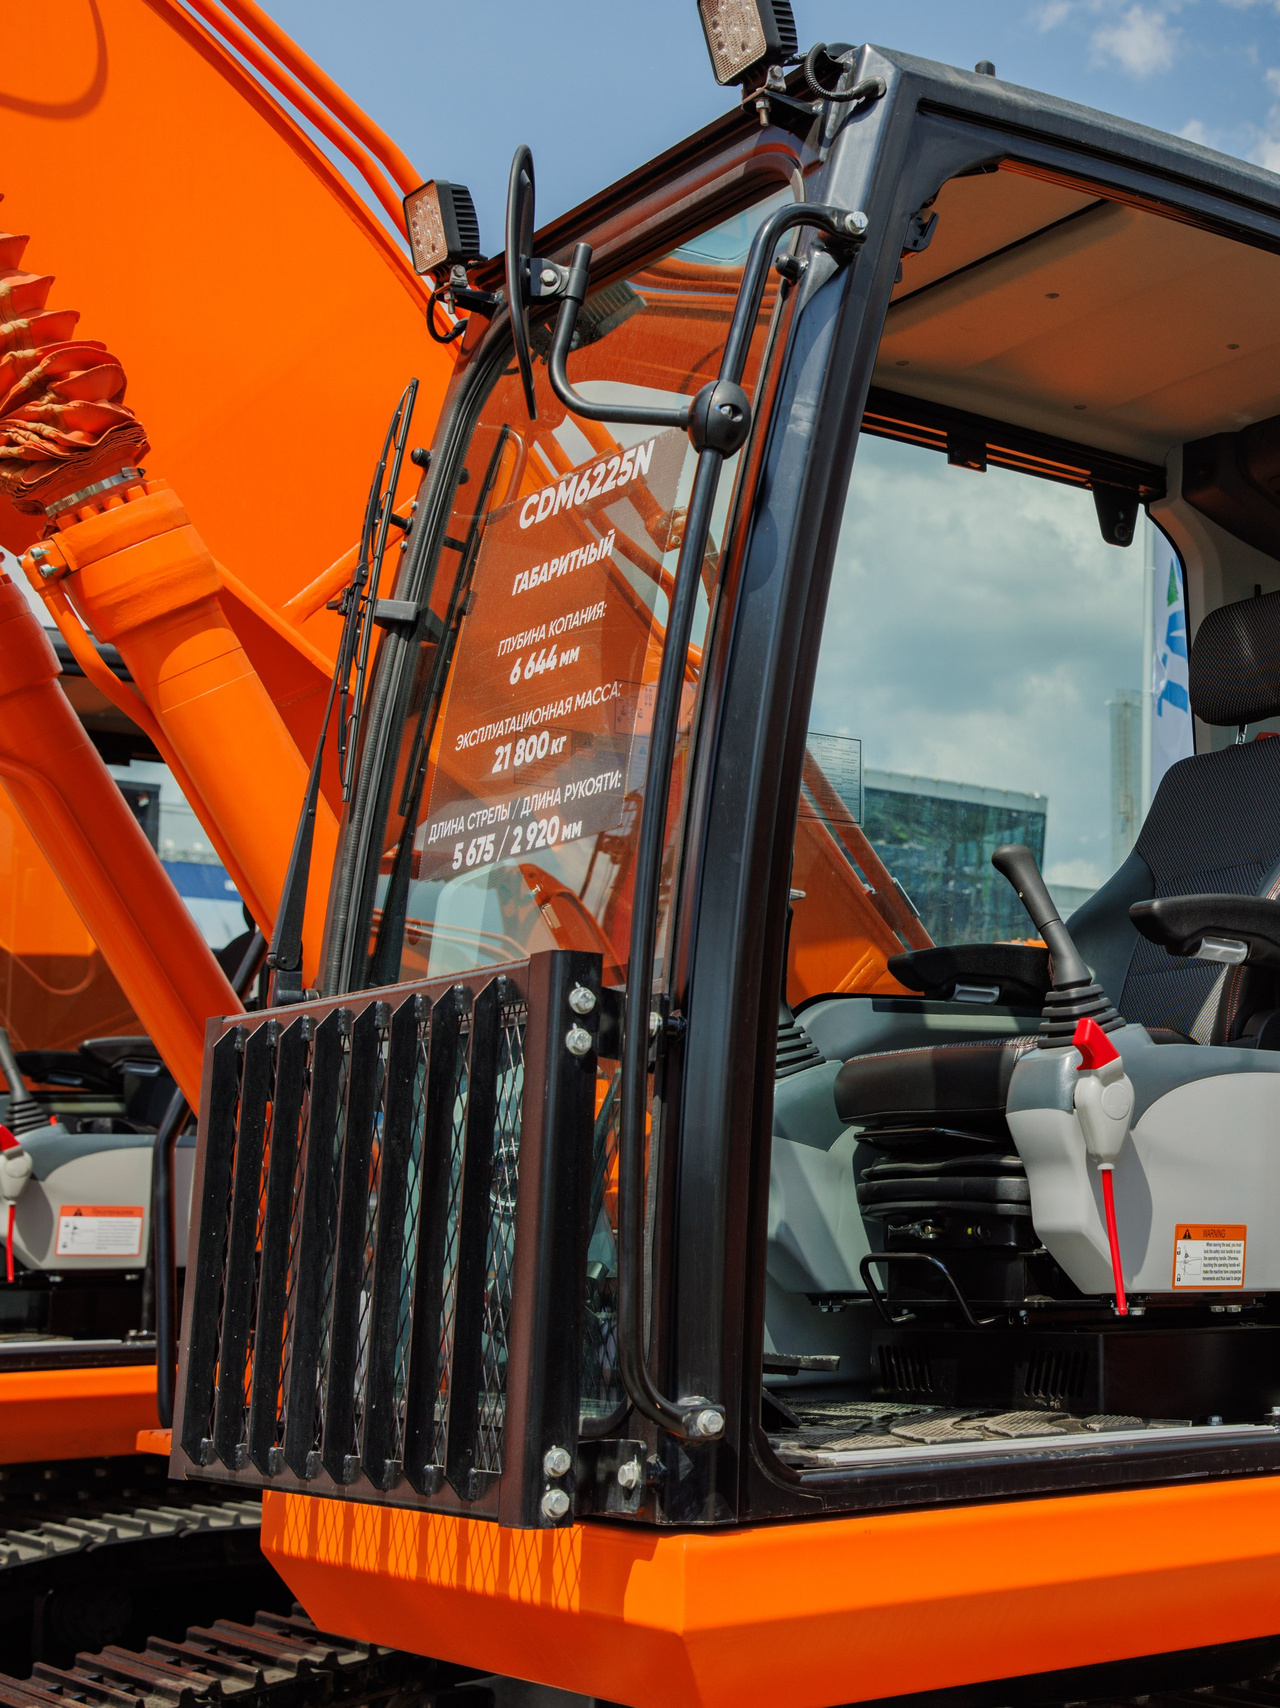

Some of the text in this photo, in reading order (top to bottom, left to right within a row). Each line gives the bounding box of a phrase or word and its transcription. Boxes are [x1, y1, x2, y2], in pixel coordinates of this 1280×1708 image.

[519, 439, 656, 530] CDM6225N
[511, 528, 616, 597] ГАБАРИТНЫЙ
[497, 601, 608, 657] ГЛУБИНА КОПАНИЯ:
[559, 646, 581, 668] мм
[455, 696, 574, 751] ЭКСПЛУАТАЦИОННАЯ
[574, 680, 623, 712] МАССА:
[550, 735, 568, 756] кг
[427, 815, 465, 845] ДЛИНА
[467, 802, 512, 831] СТРЕЛЫ
[520, 787, 562, 817] ДЛИНА
[564, 770, 623, 803] РУКОЯТИ:
[561, 820, 583, 842] мм
[1202, 1228, 1226, 1239] WARNING
